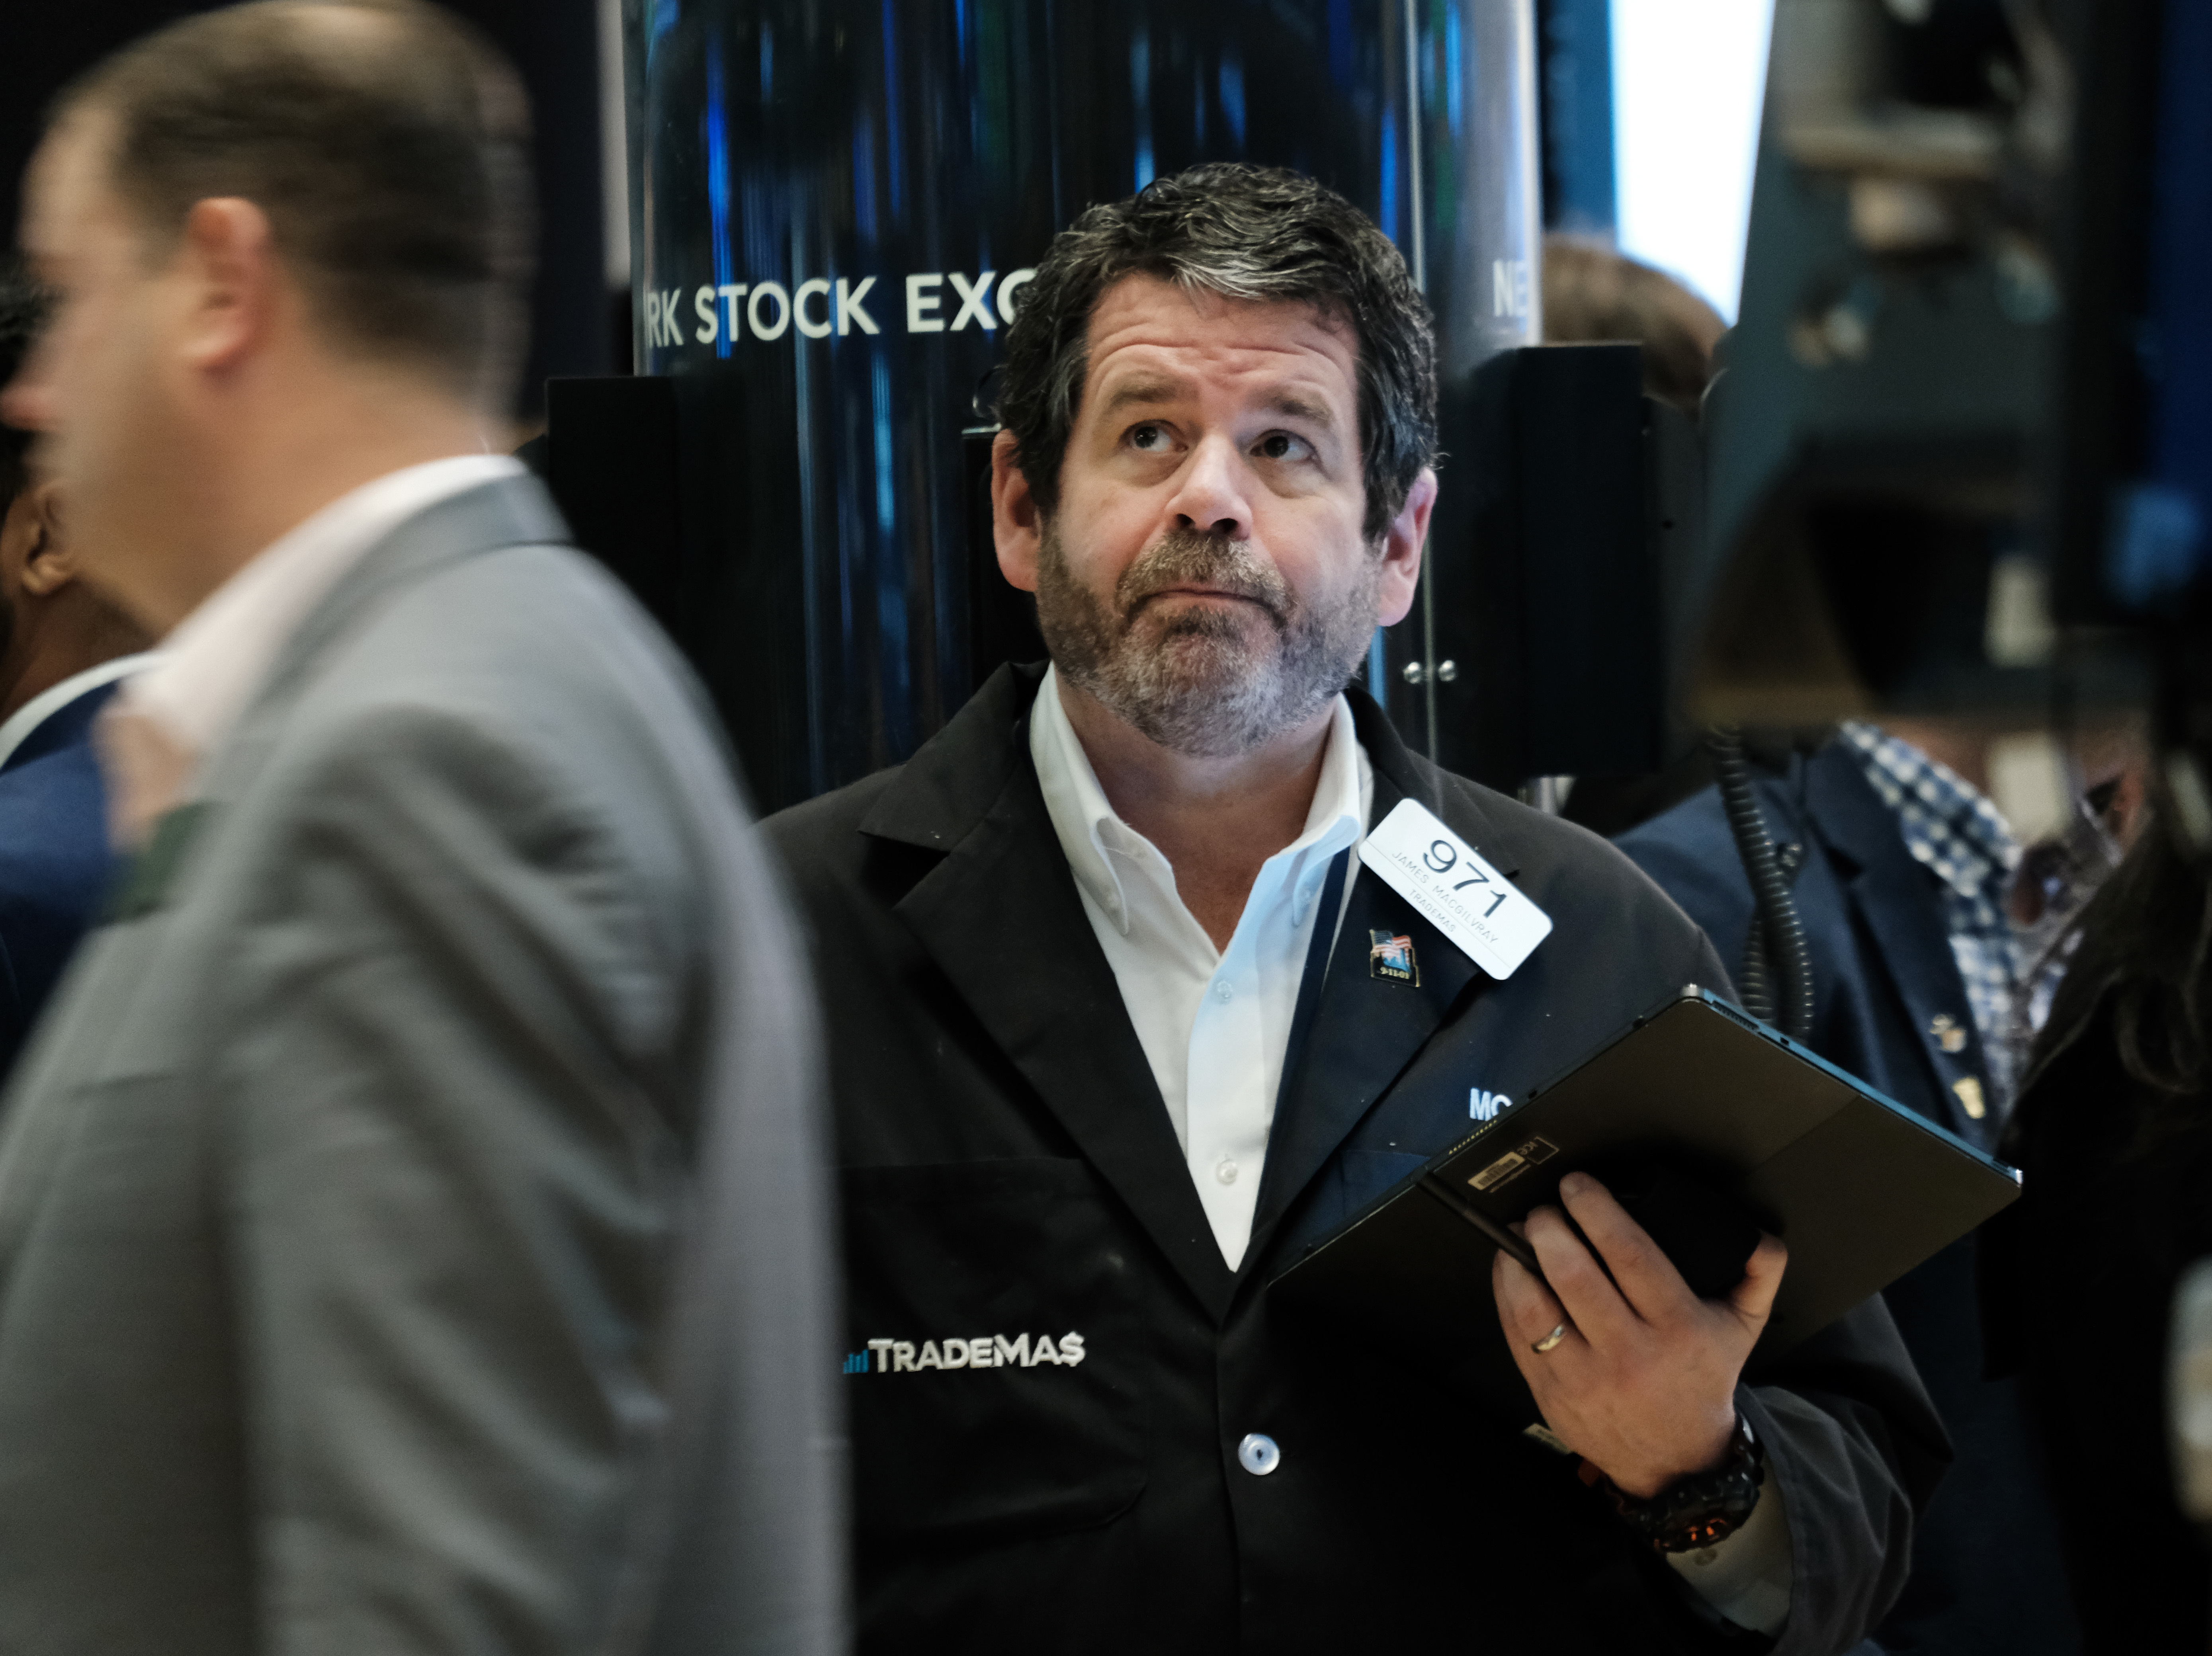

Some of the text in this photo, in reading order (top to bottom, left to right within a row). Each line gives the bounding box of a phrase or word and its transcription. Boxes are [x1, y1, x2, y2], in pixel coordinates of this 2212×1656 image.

[694, 275, 881, 345] STOCK
[1392, 852, 1430, 884] JAMES
[1423, 840, 1508, 919] 971
[1409, 889, 1457, 933] TRADEMAS
[1432, 885, 1499, 944] MACGILVRAY
